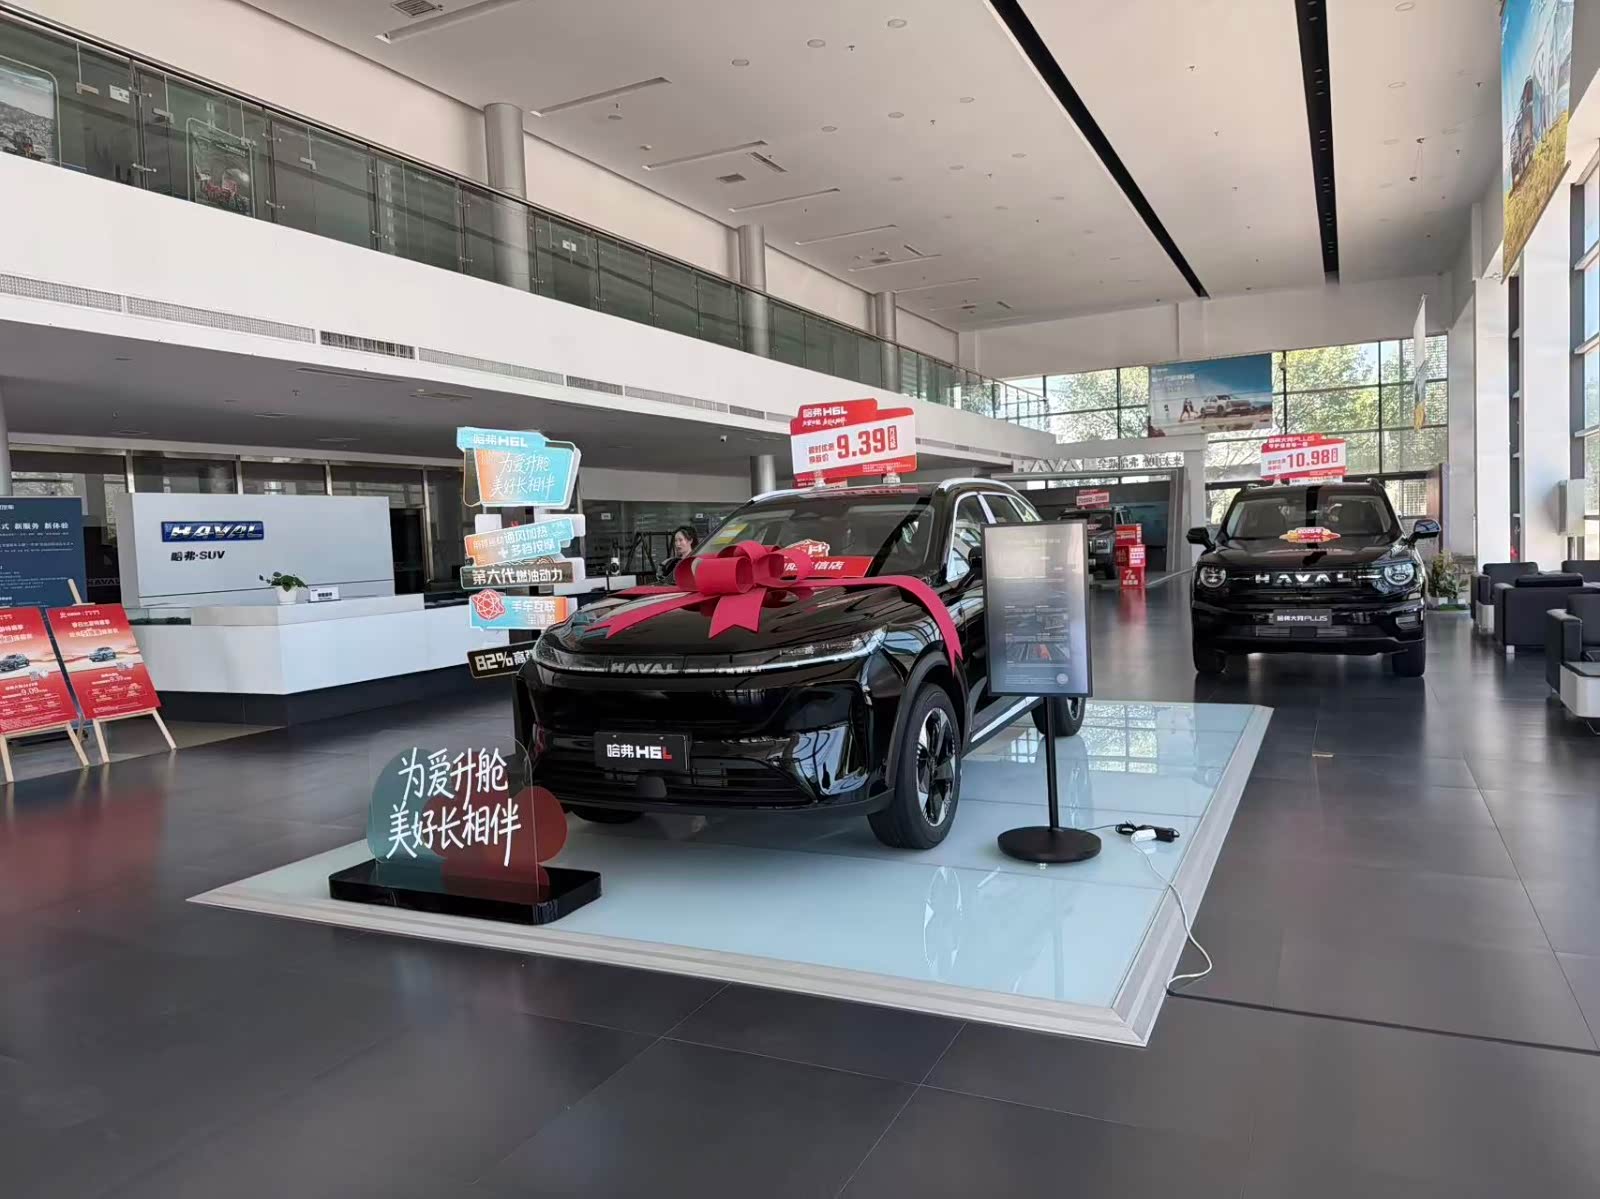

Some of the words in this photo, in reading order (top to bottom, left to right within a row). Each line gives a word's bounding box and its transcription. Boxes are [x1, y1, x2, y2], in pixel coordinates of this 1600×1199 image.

[802, 406, 848, 418] 哈弗H6L
[473, 433, 528, 448] 哈弗H6L
[836, 428, 886, 459] 9.39
[1287, 449, 1330, 468] 10.98
[490, 472, 556, 500] 美好长相伴
[15, 522, 39, 530] 新服务
[169, 525, 262, 539] HAVAL
[472, 568, 563, 586] 第六代燃油动力
[1255, 573, 1352, 585] HAVAL
[511, 600, 556, 613] 手车互联
[610, 662, 679, 674] HAVAL
[606, 744, 673, 760] 哈弗H6L
[398, 747, 508, 810] 为爱升舱
[386, 797, 522, 867] 美好长相伴
